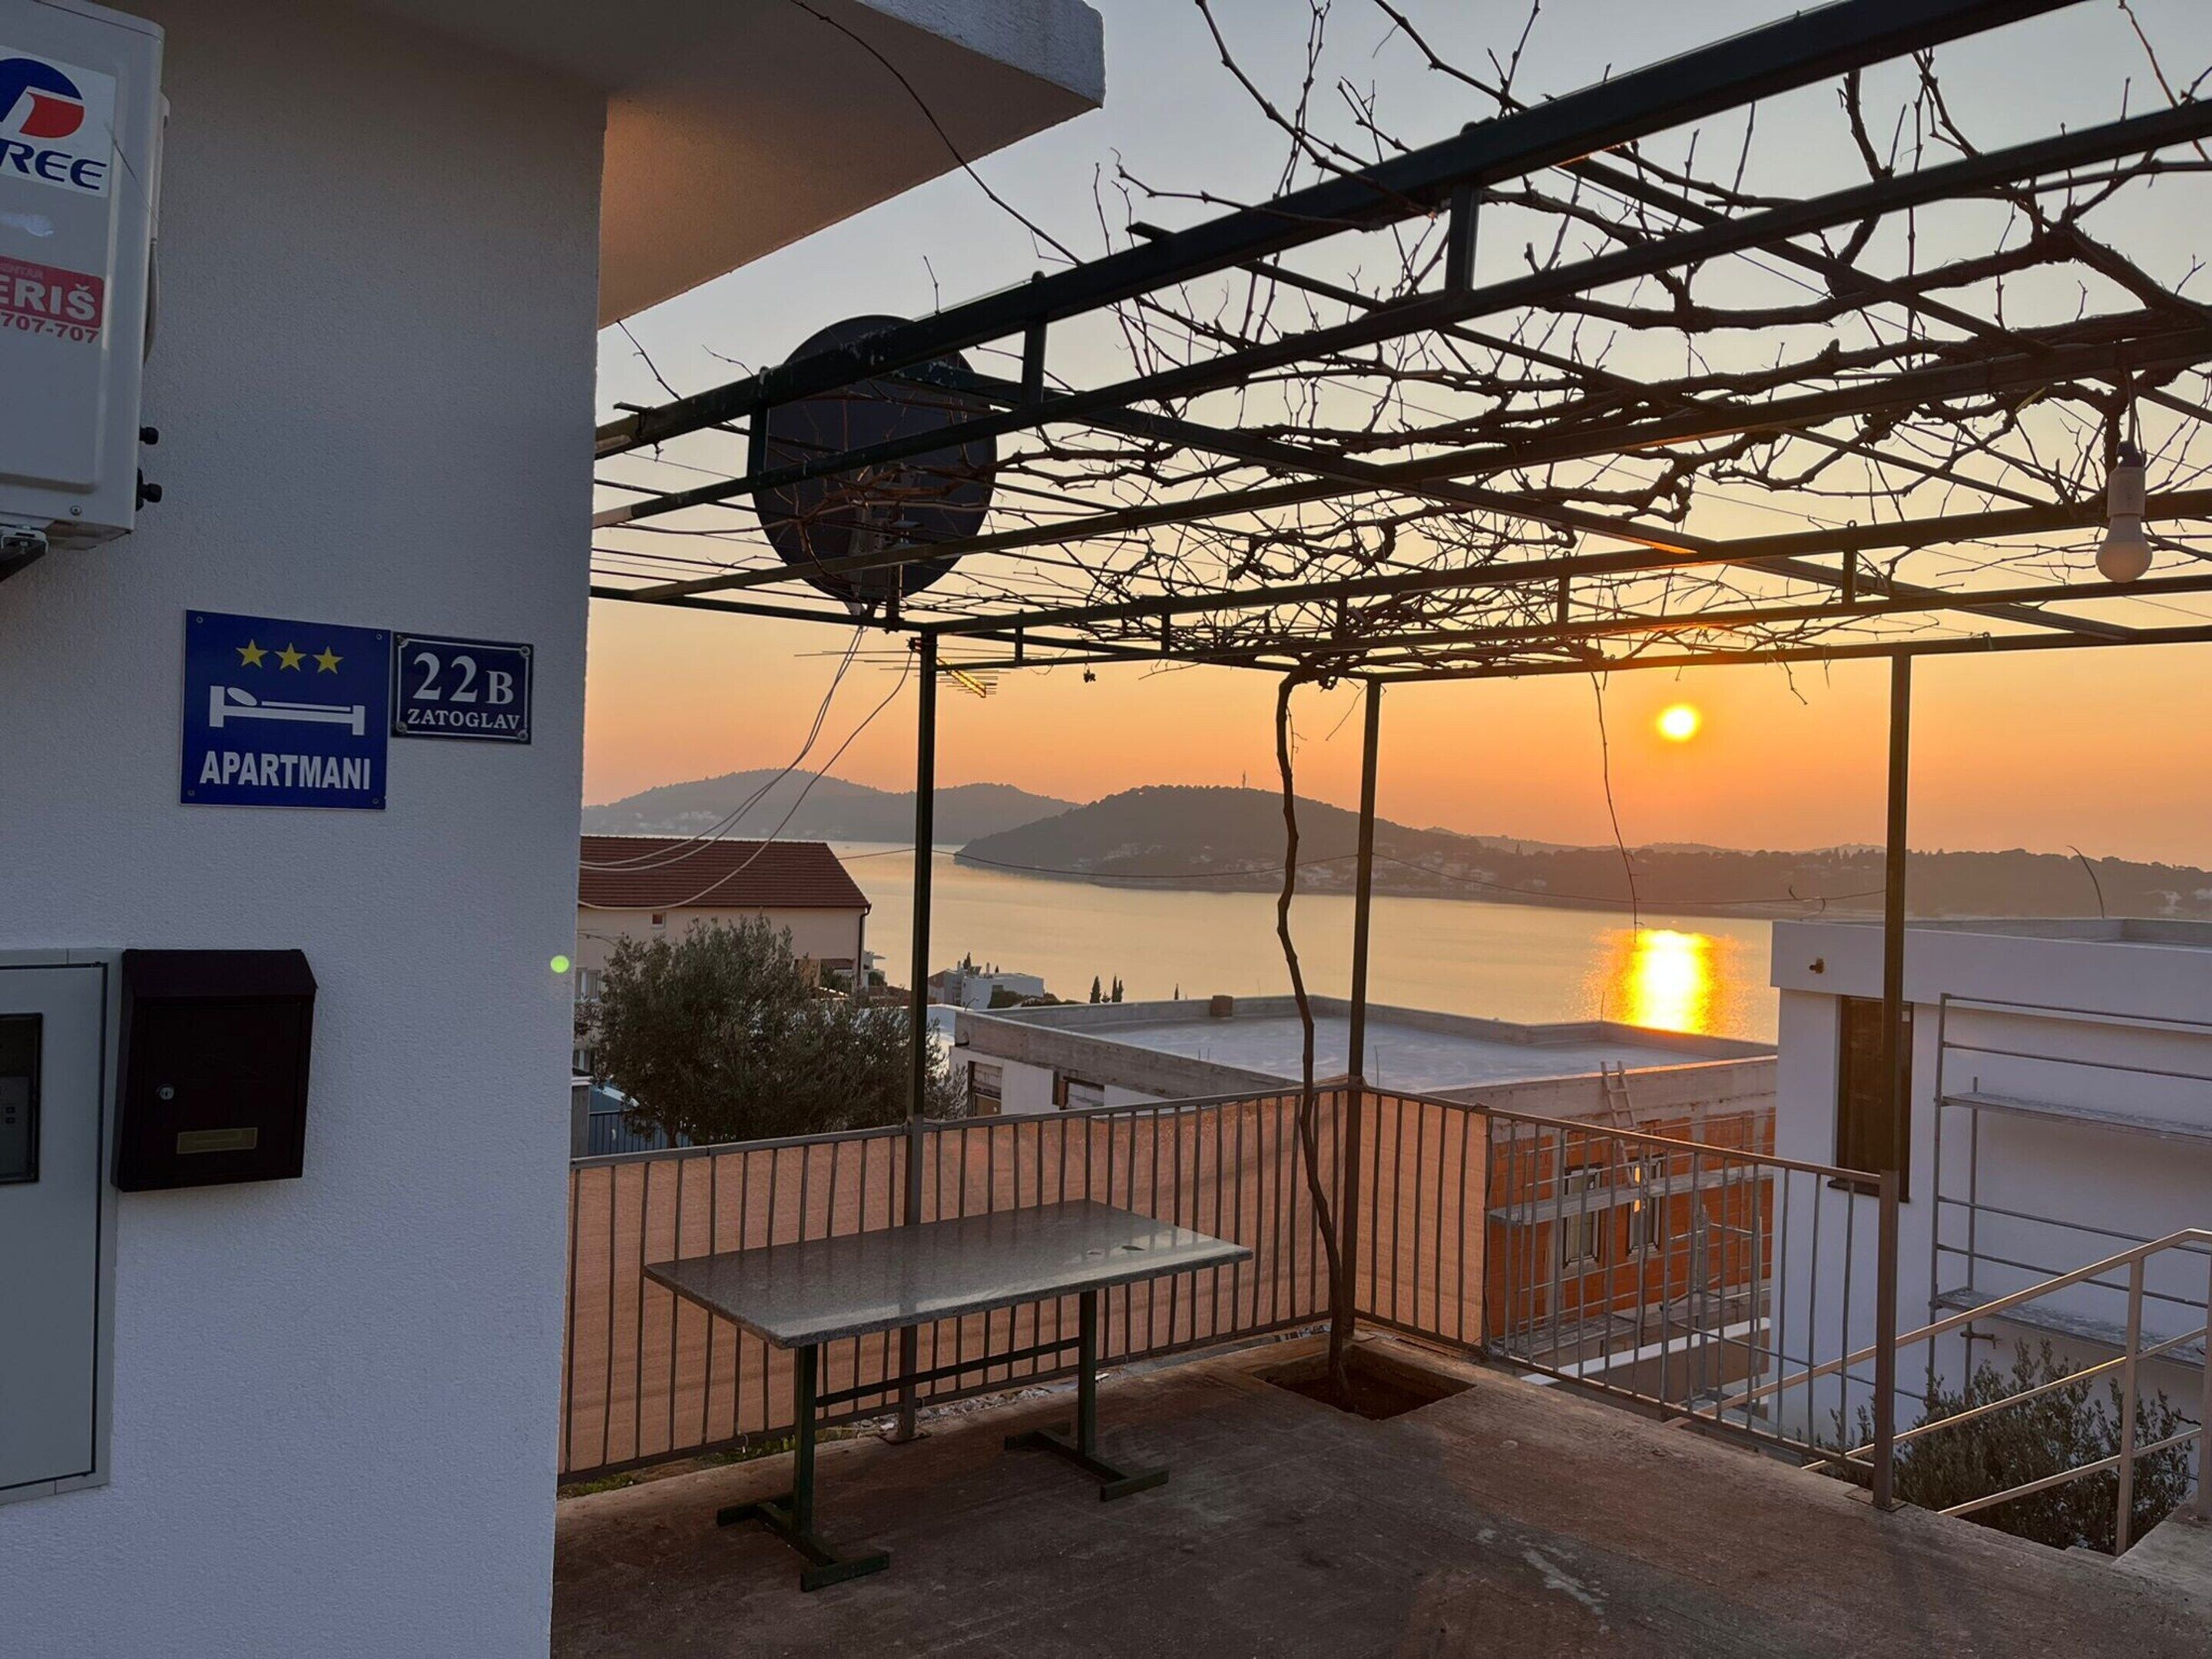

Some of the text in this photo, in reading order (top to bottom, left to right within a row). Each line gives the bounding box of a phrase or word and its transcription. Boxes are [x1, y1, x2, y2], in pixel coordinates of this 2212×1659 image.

[1, 312, 99, 343] 707-707
[407, 708, 521, 730] ZATOGLAV
[199, 750, 370, 790] APARTMANI
